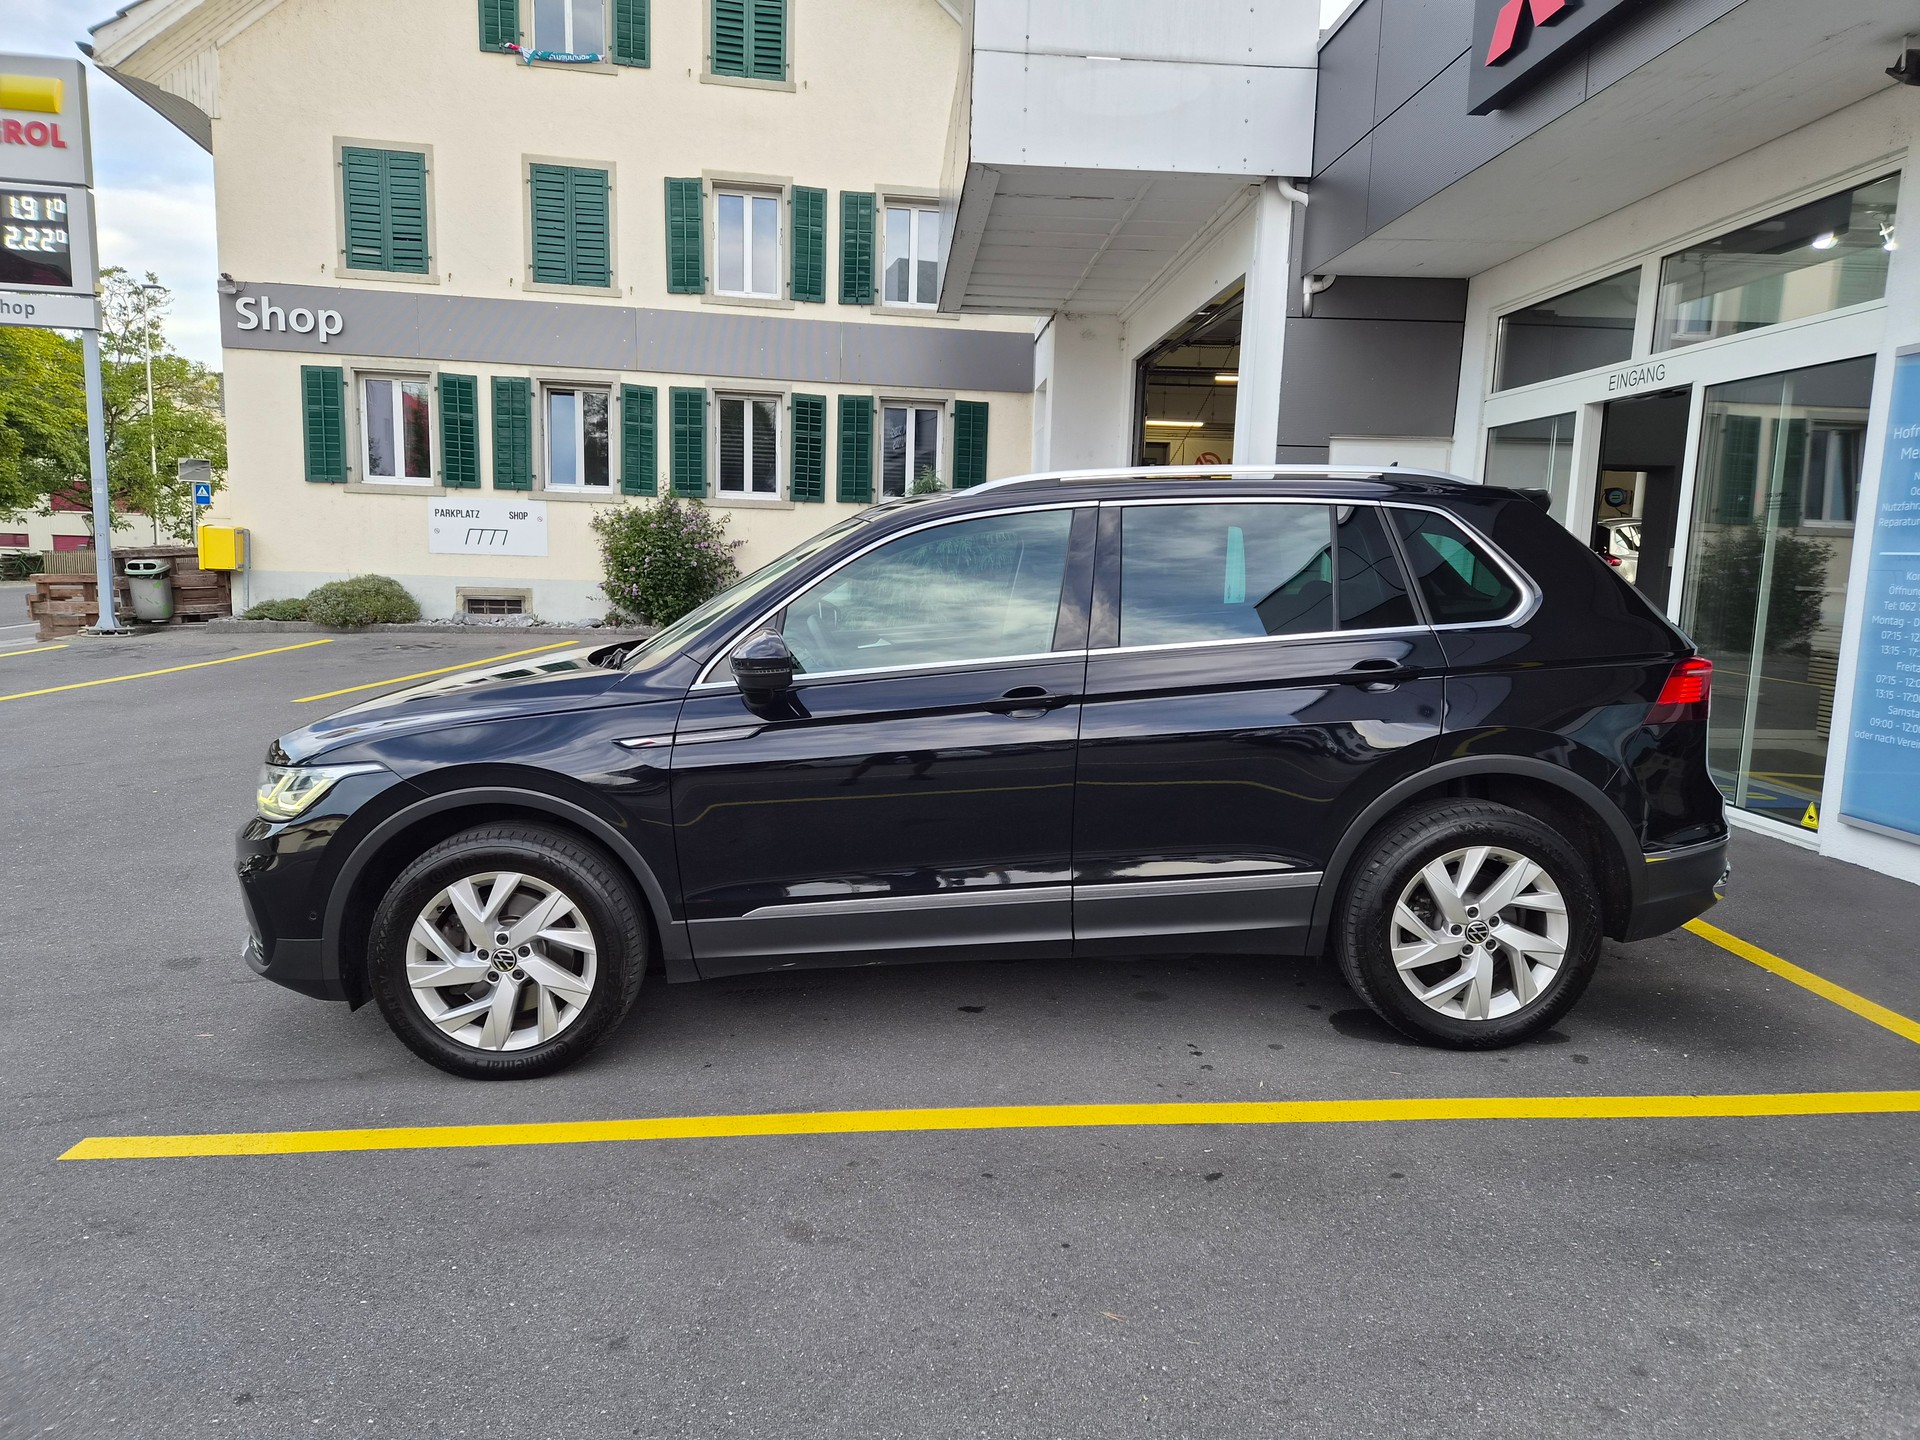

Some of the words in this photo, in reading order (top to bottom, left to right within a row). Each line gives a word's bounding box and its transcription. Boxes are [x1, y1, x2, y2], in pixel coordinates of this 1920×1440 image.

[0, 118, 67, 148] ROL
[235, 295, 344, 344] Shop
[1608, 363, 1665, 391] EINGANG
[1901, 447, 1920, 460] Me
[434, 508, 480, 519] PARKPLATZ
[508, 511, 529, 521] SHOP
[1871, 614, 1905, 628] Montag
[1870, 717, 1893, 729] 09:00
[1854, 730, 1873, 740] oder
[1875, 734, 1895, 744] nach
[429, 852, 514, 884] Continental
[486, 1040, 571, 1071] Continental
